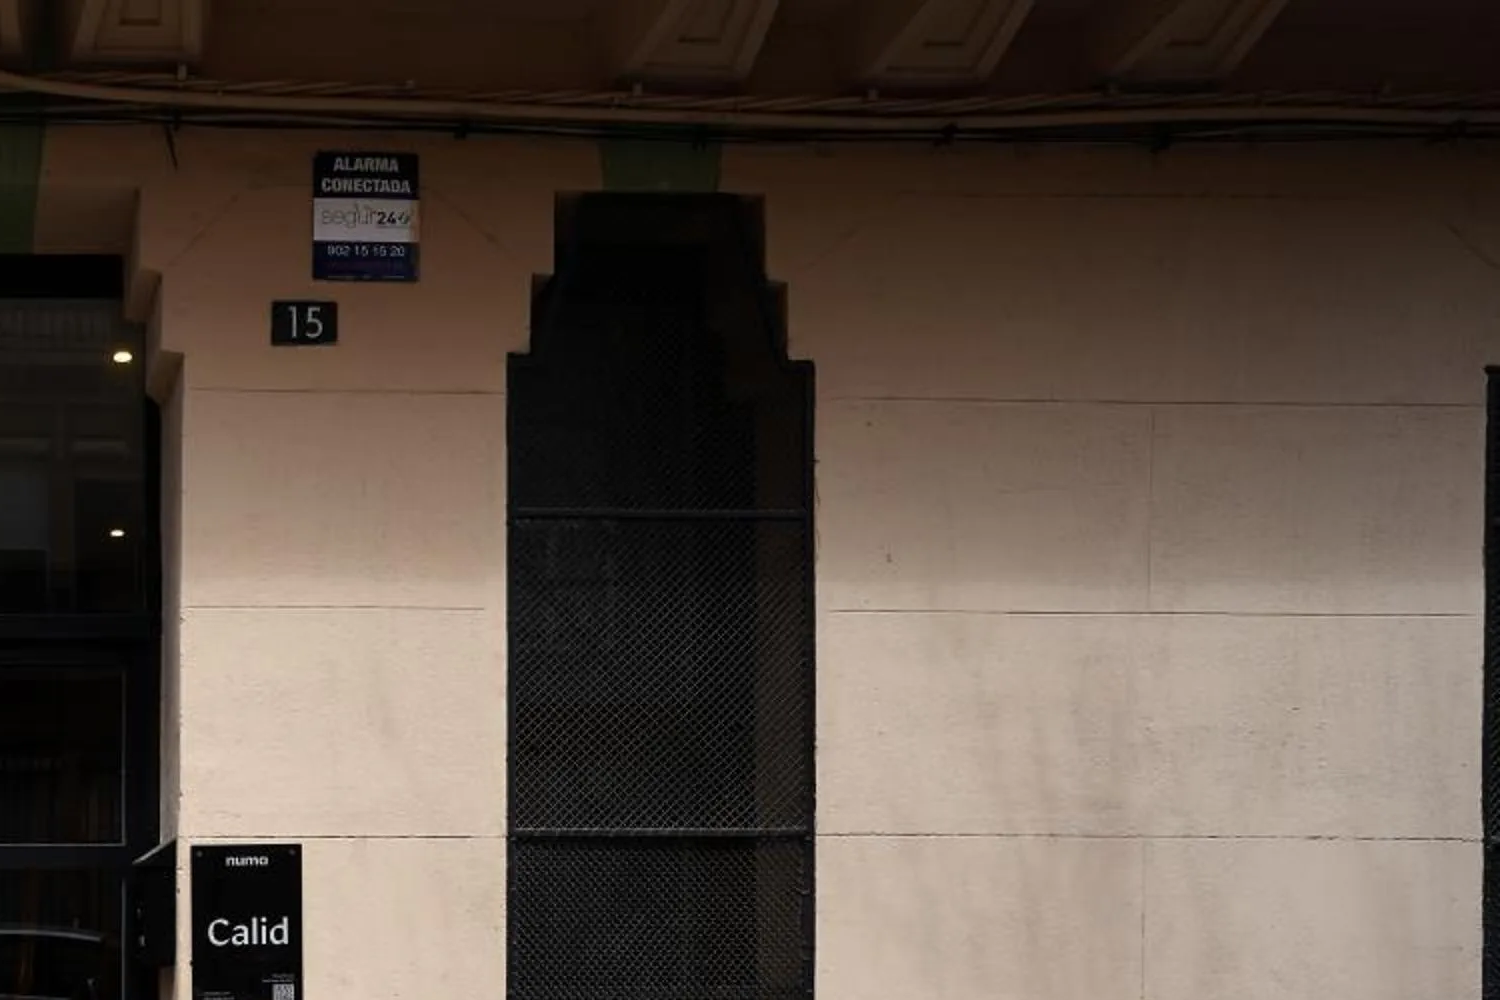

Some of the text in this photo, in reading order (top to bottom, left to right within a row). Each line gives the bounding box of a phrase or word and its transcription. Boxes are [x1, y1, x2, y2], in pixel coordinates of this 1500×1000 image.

[333, 157, 399, 172] ALARMA
[321, 177, 411, 194] CONECTADA
[288, 305, 324, 339] 15
[207, 916, 289, 947] Calid
